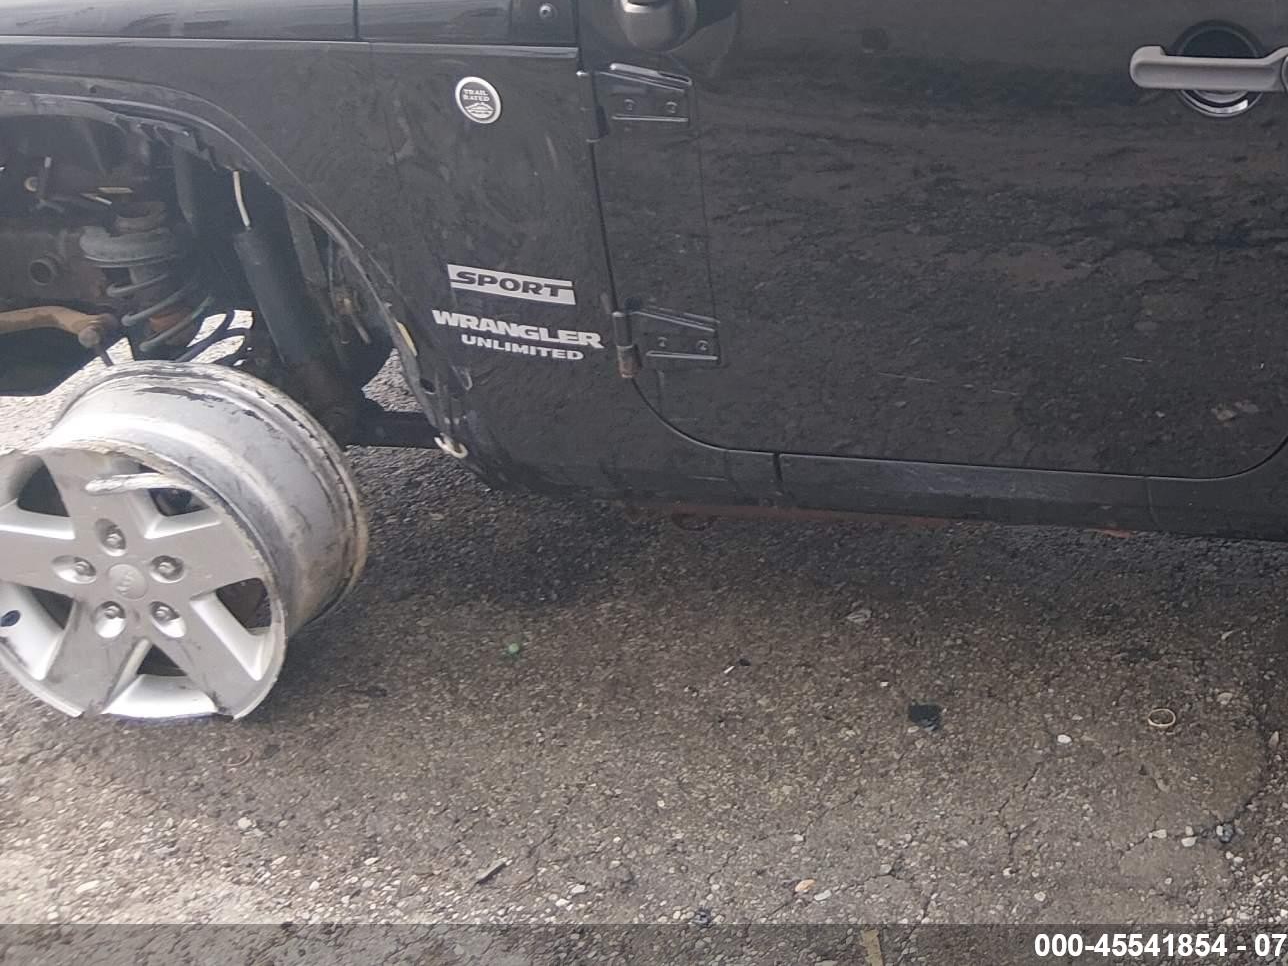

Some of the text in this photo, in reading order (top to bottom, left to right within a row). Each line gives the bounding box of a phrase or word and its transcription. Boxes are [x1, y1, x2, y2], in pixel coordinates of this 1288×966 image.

[455, 271, 564, 298] SPORT
[432, 309, 604, 349] WRANGLER
[461, 335, 584, 360] UNLIMITED
